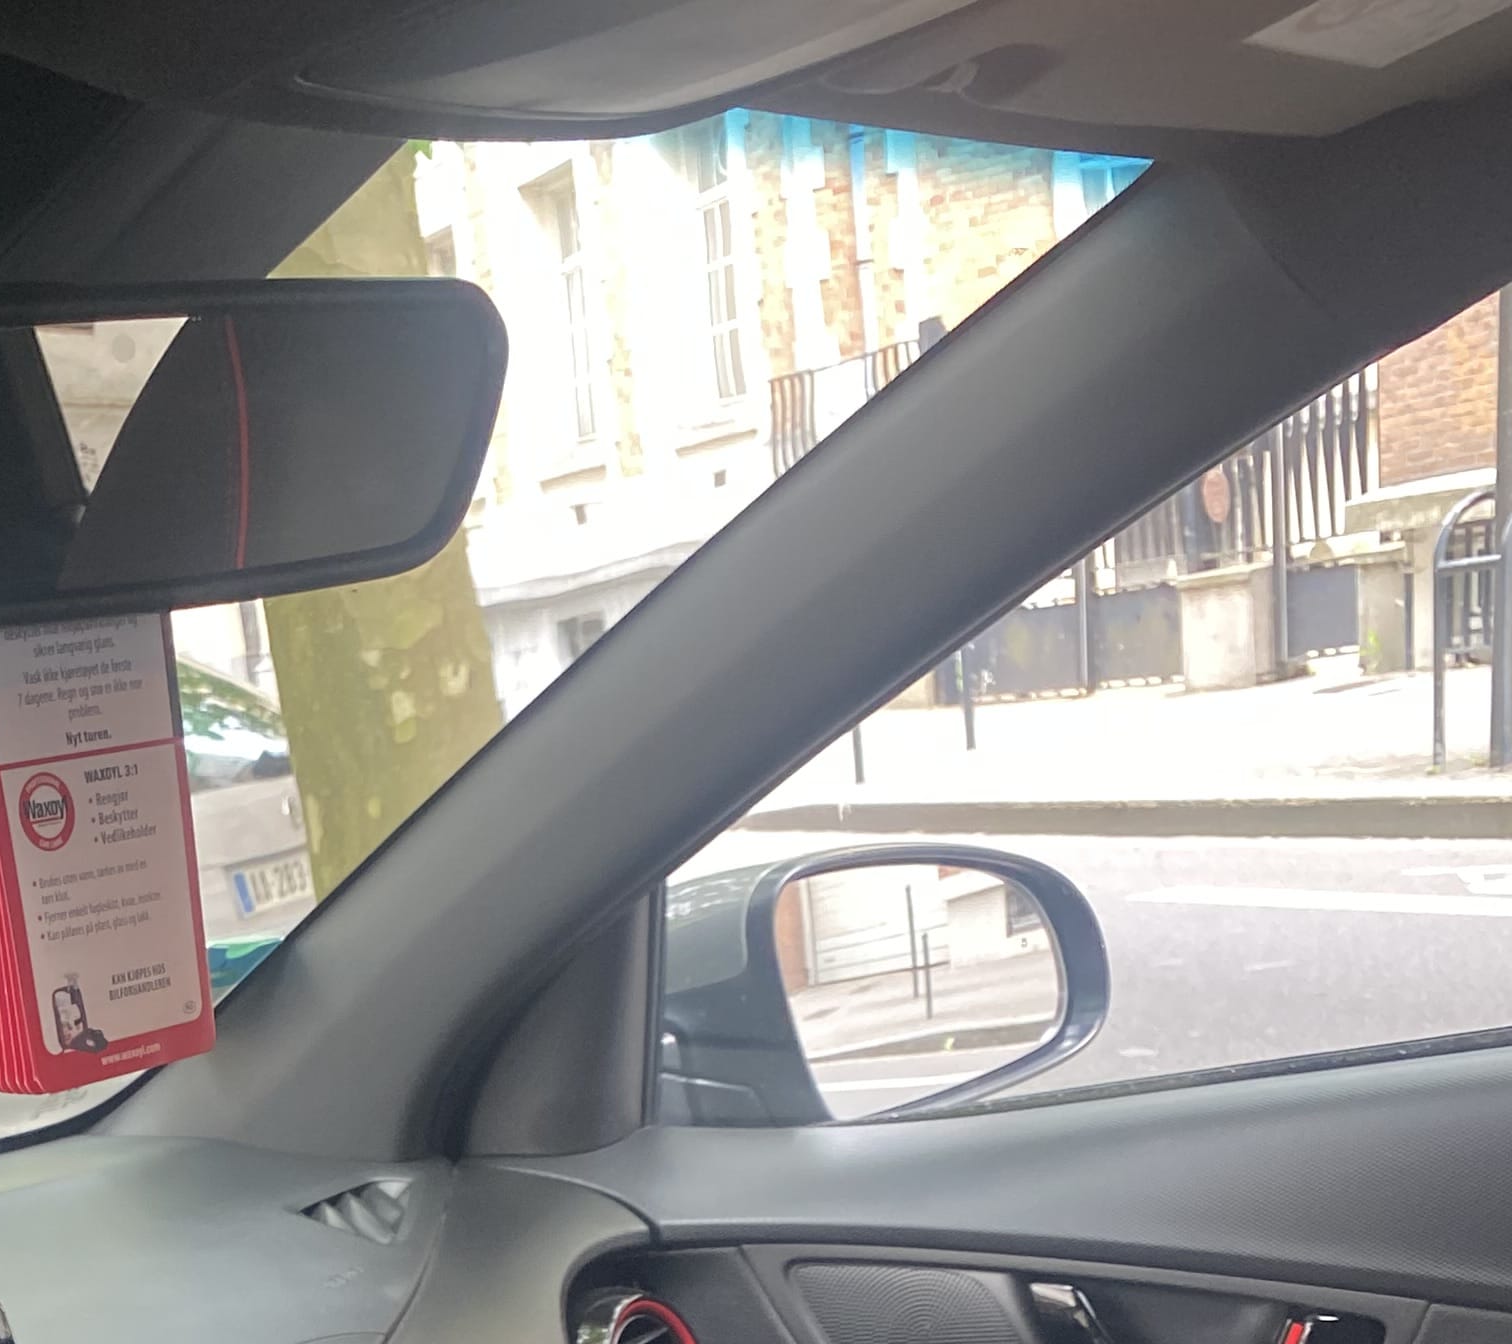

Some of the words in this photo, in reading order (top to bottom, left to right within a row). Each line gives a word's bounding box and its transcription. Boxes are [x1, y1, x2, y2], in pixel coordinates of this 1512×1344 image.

[66, 730, 83, 748] Nyt
[83, 728, 112, 744] turen.
[84, 767, 122, 784] WAXOYL
[125, 763, 139, 777] 3:1
[98, 808, 139, 827] Beskytter
